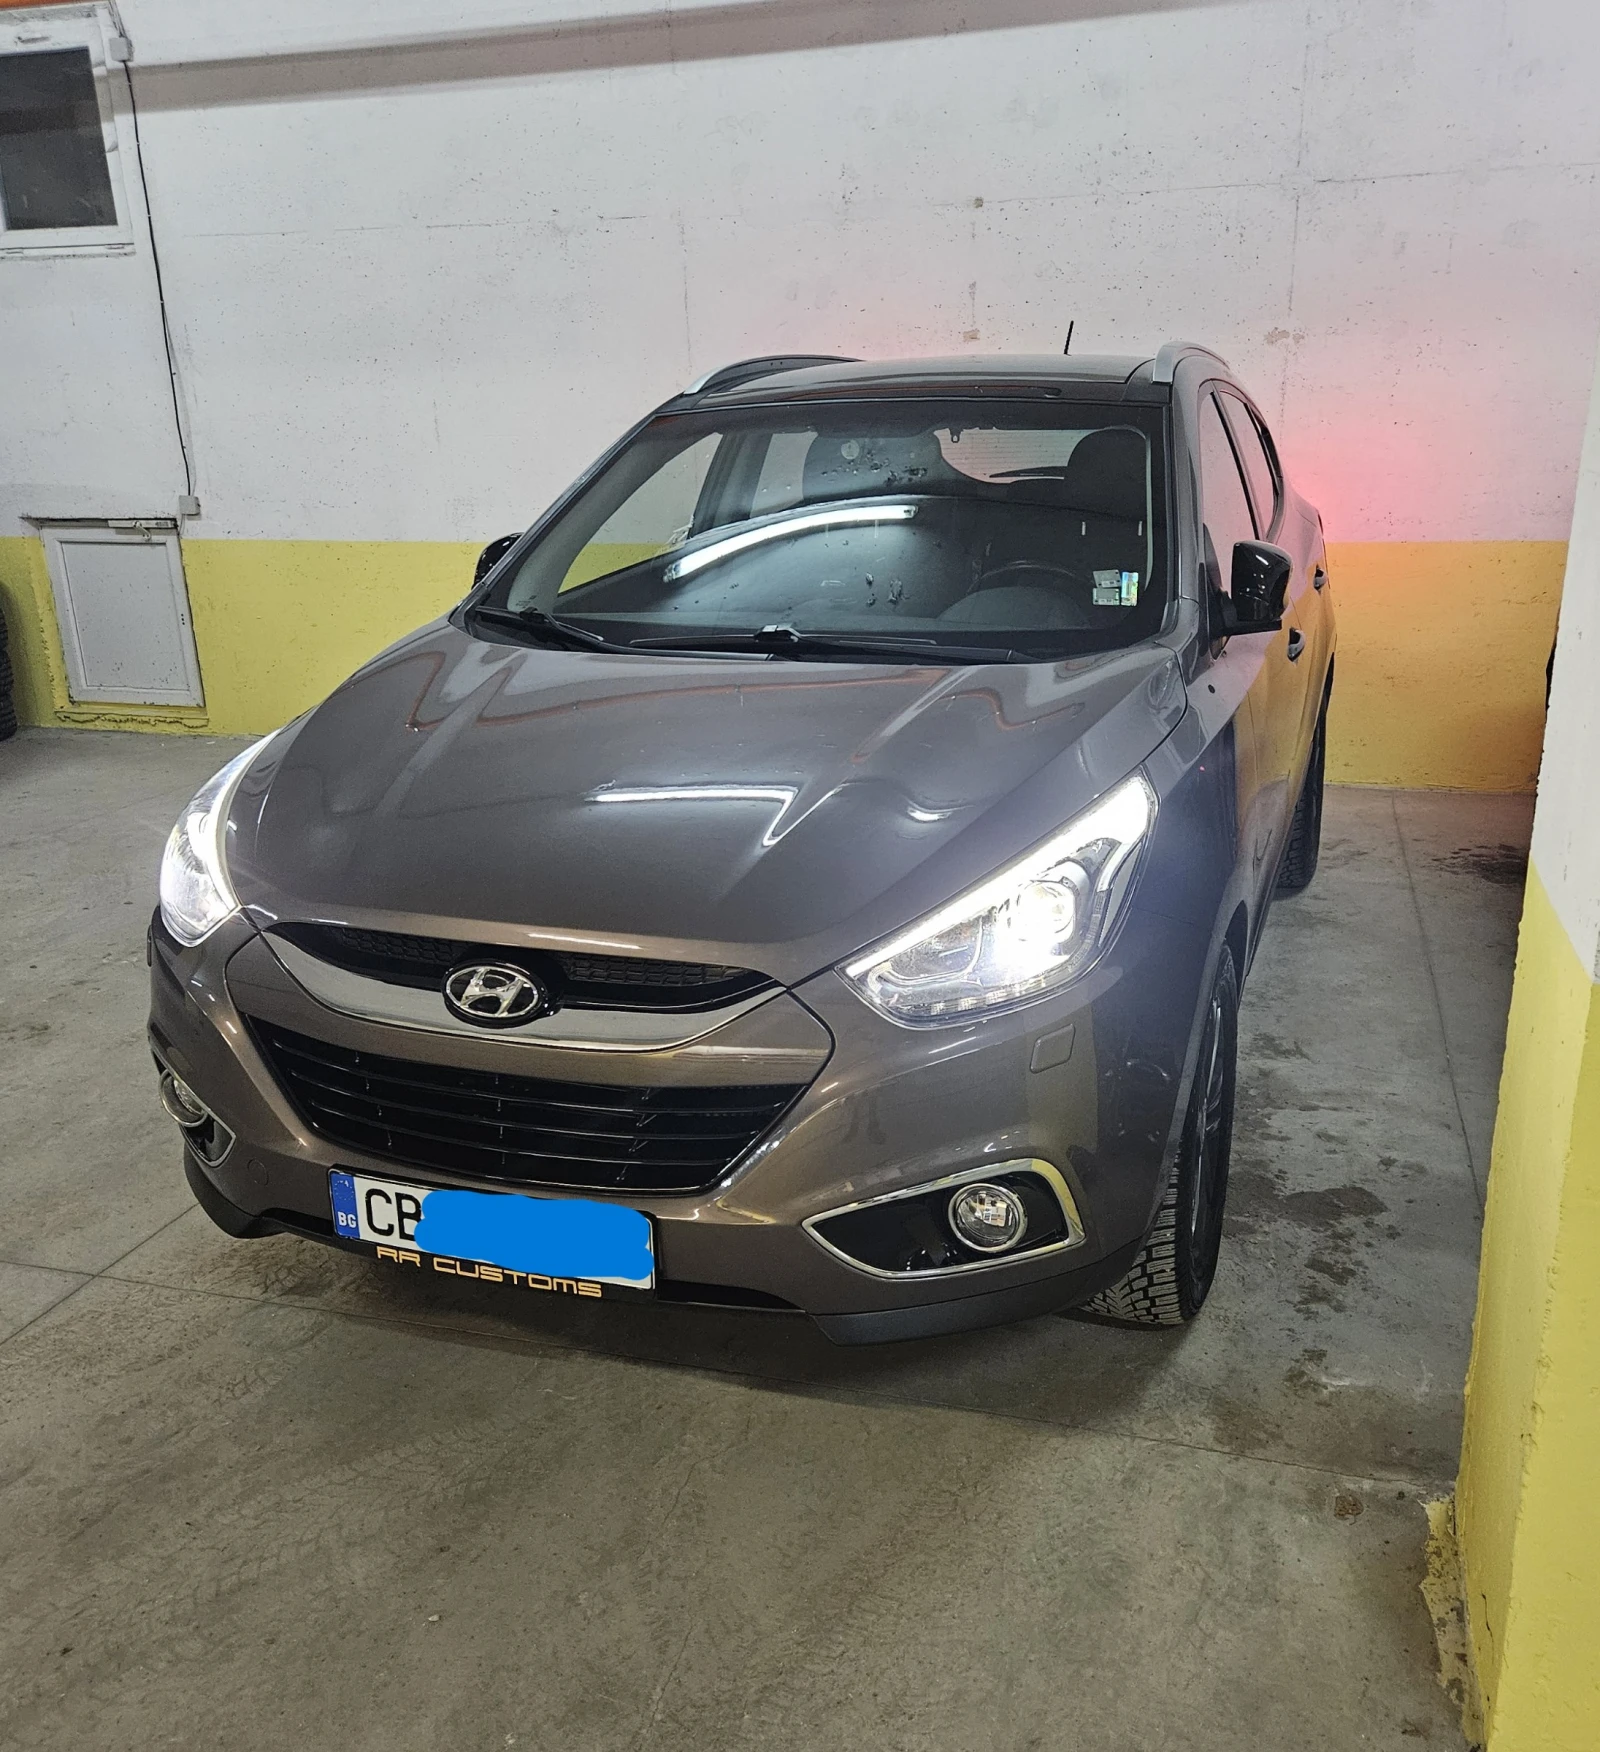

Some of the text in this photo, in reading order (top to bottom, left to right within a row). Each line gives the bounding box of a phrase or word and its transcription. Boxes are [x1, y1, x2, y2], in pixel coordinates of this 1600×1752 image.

[337, 1212, 356, 1228] BG
[376, 1246, 602, 1298] RR CUSTOMS
